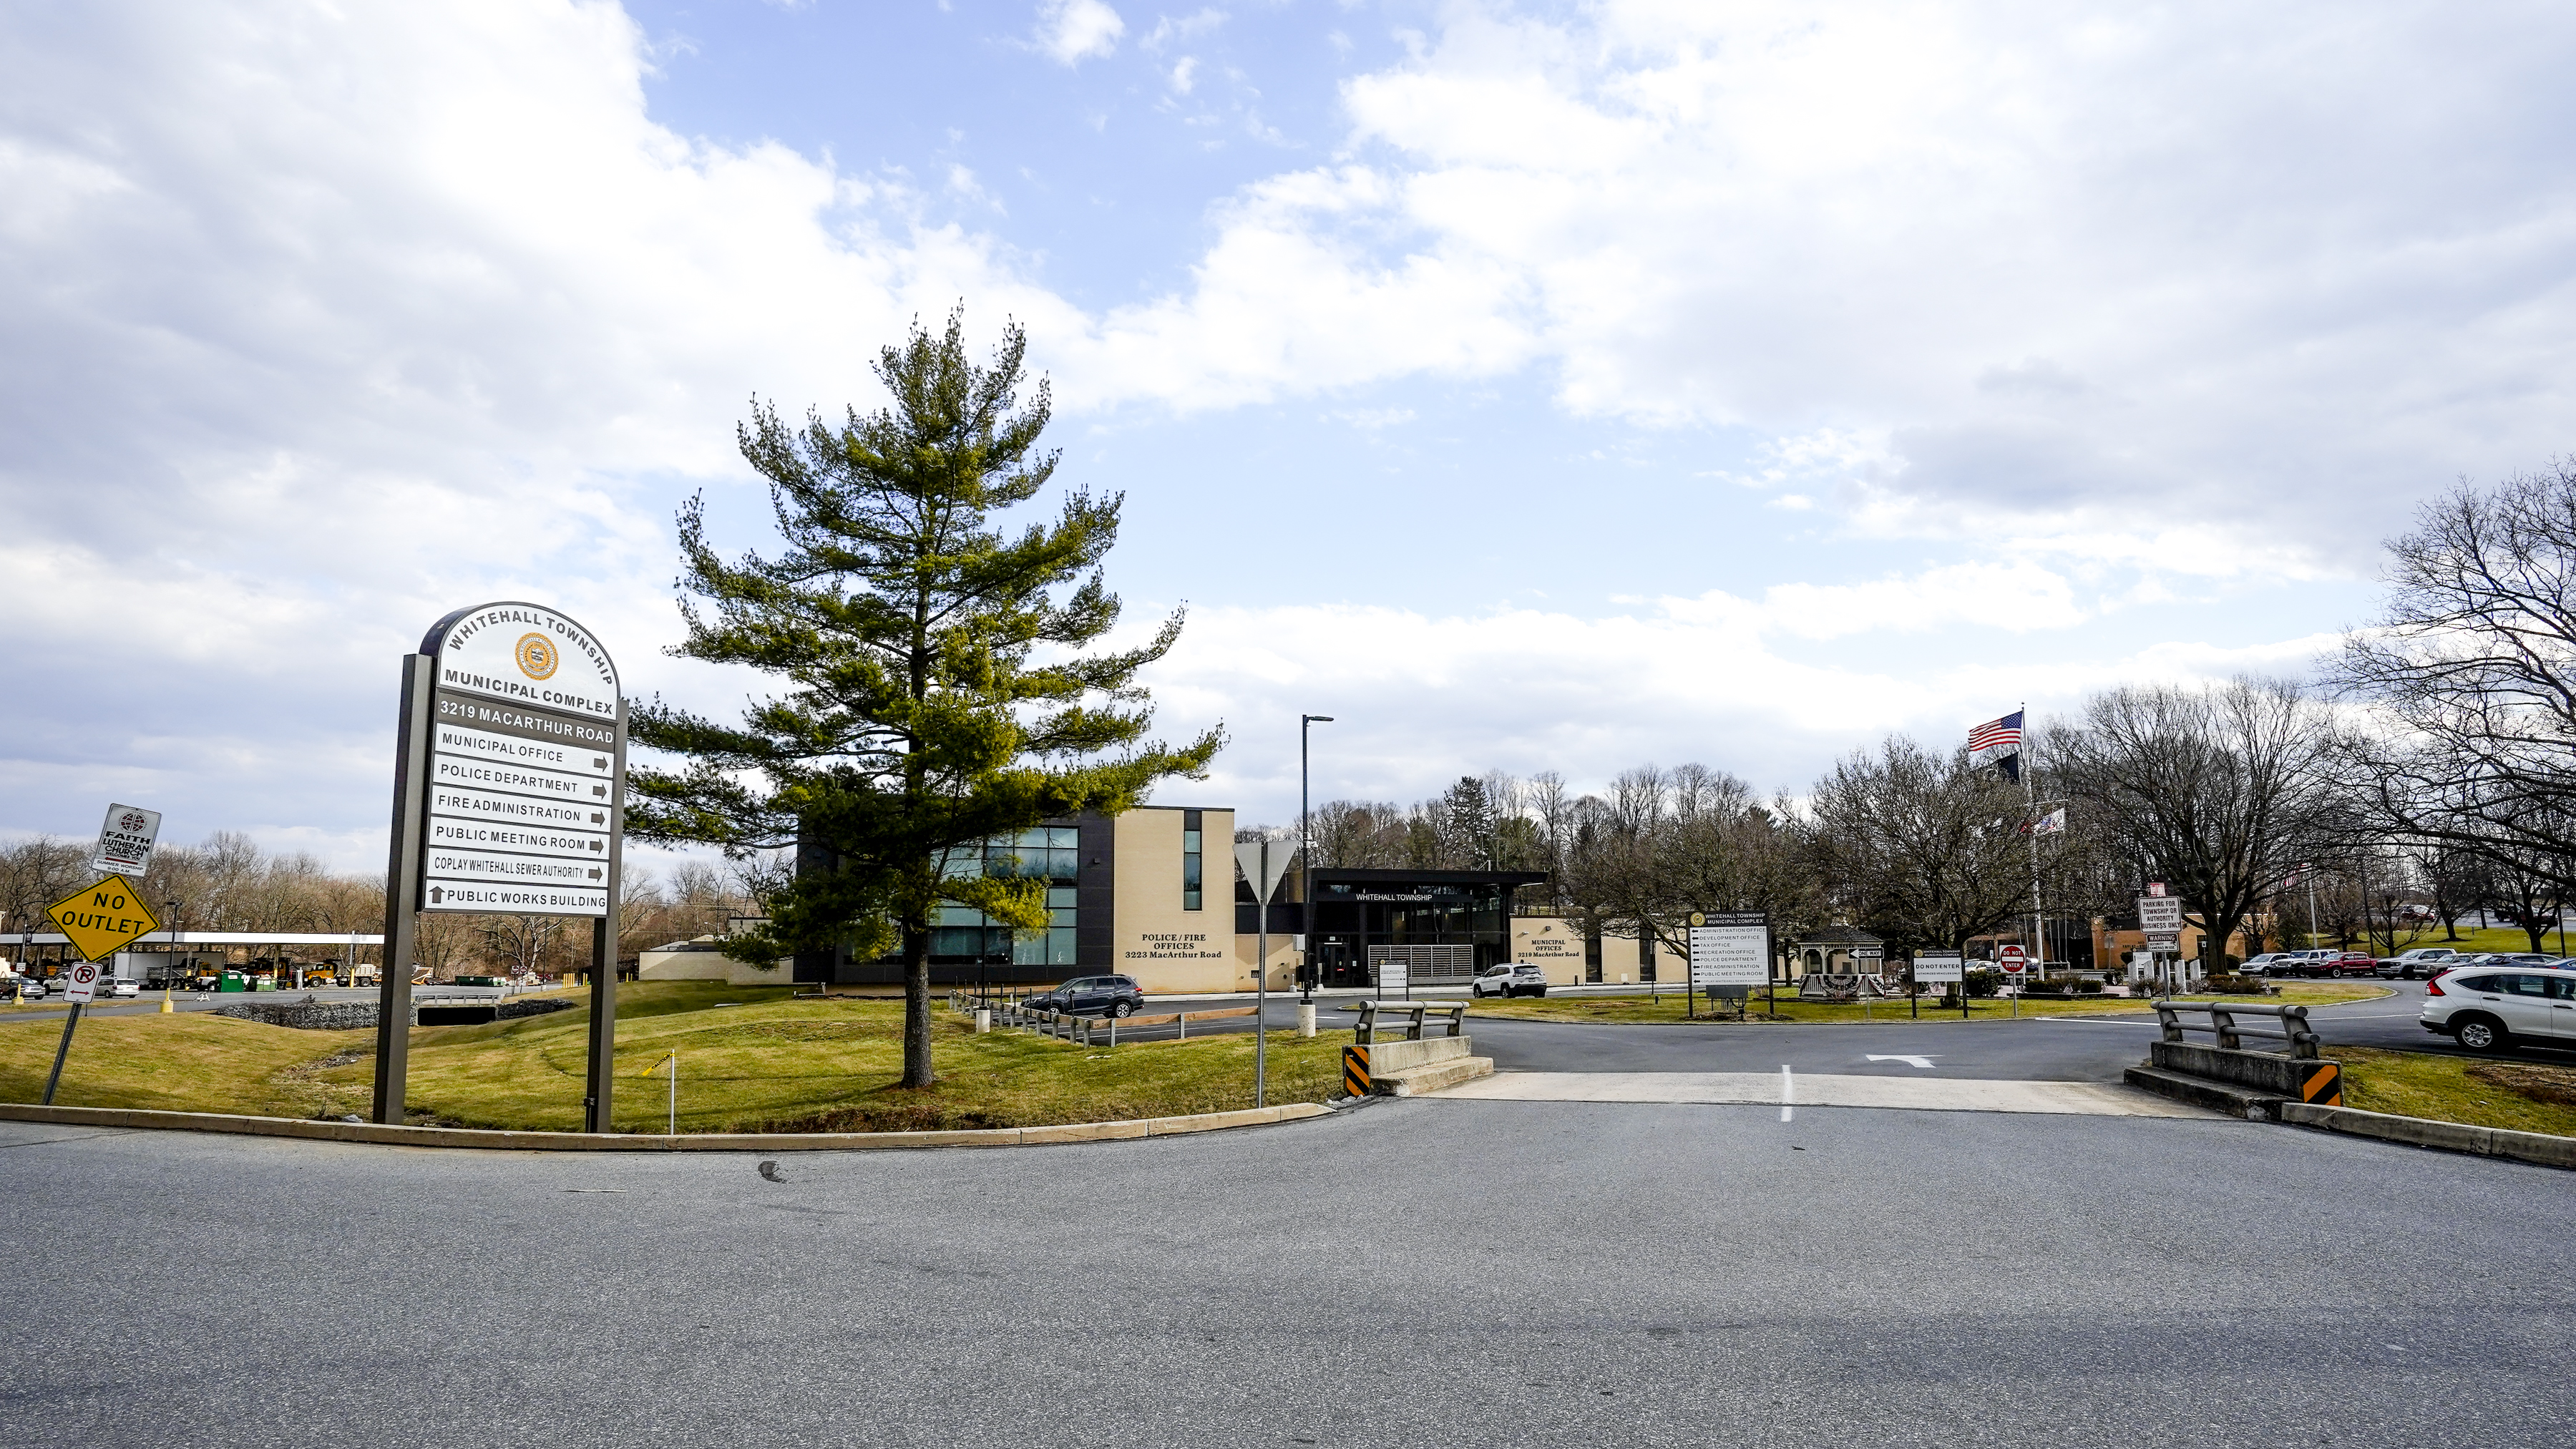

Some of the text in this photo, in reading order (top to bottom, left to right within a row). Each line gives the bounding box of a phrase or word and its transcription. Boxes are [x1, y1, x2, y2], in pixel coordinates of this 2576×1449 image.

[449, 610, 613, 685] WHITEHALL TOWNSHIP
[445, 669, 613, 715] MUNICIPAL COMPLEX
[440, 700, 614, 743] 3219 MACARTHUR ROAD
[442, 733, 563, 762] MUNICIPAL OFFICE
[441, 763, 578, 793] POLICE DEPARTMENT
[438, 795, 580, 821] FIRE ADMINISTRATION
[102, 838, 150, 852] LUTHERAN
[105, 831, 151, 844] FAITH
[436, 826, 585, 850] PUBLIC MEETING ROOM
[104, 845, 144, 857] CHURCH
[434, 857, 584, 878] COPLAY WHITEHALL SEWER AUTHORITY
[93, 892, 125, 910] NO
[447, 889, 606, 907] PUBLIC WORKS BUILDING
[62, 911, 145, 935] OUTLET
